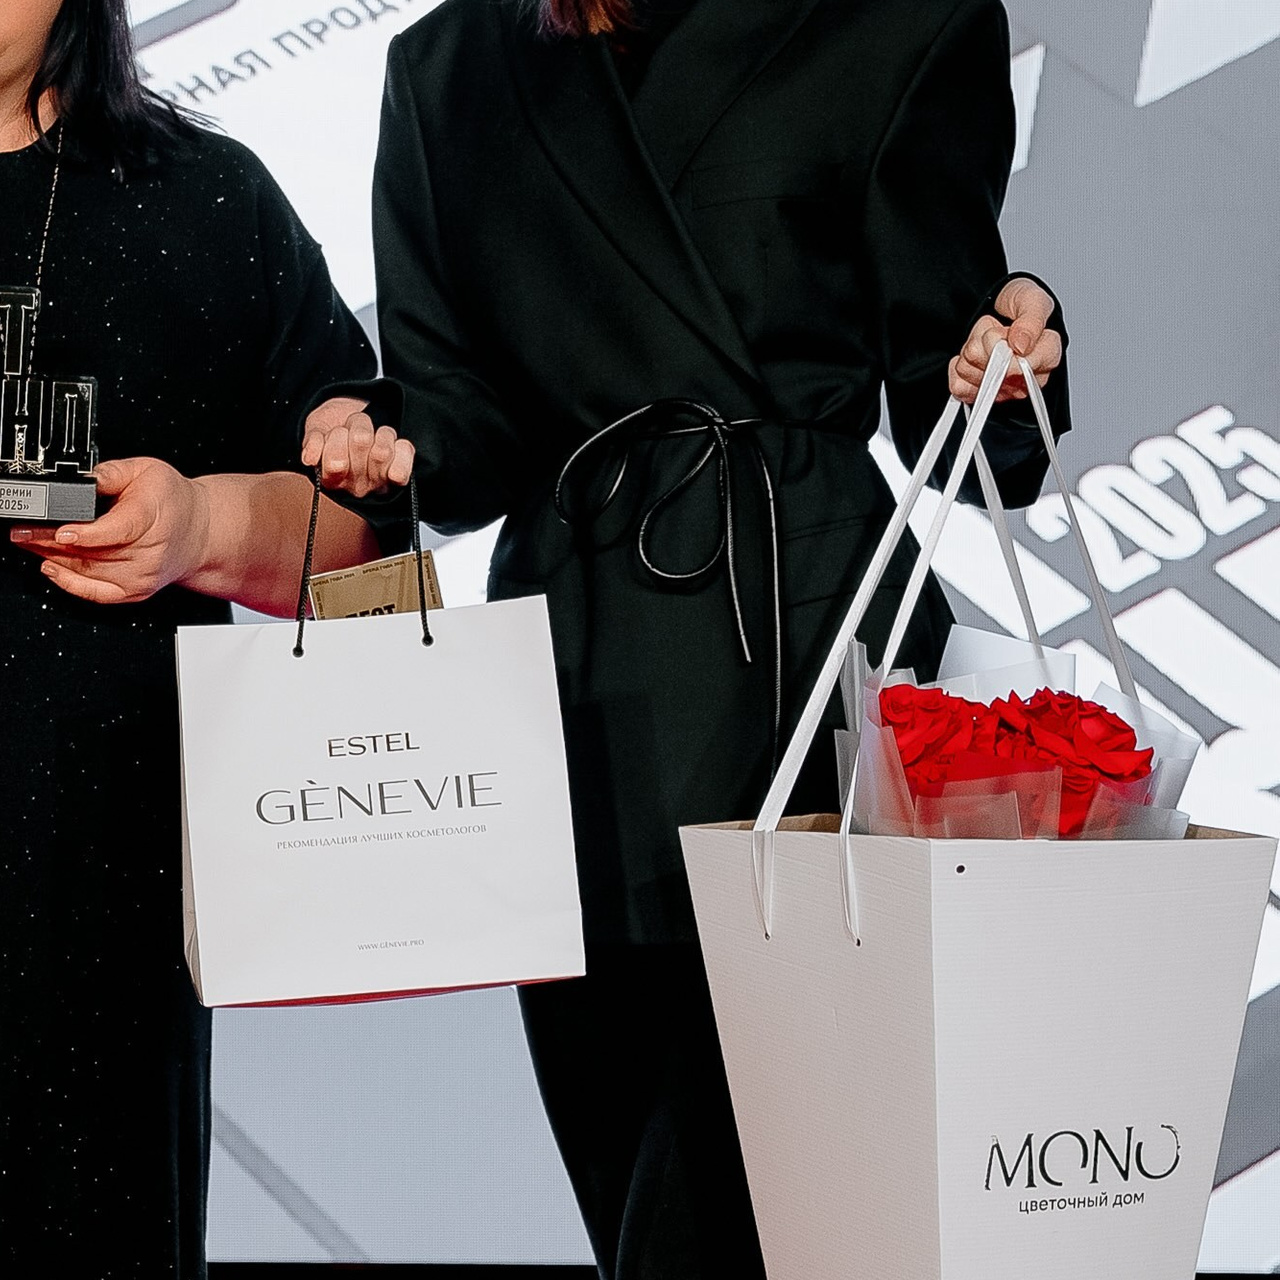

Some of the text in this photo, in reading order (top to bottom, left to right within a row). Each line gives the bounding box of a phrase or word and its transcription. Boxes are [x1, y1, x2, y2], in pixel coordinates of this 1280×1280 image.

[327, 732, 420, 758] ESTEL
[256, 772, 502, 825] GÈNEVIE
[277, 824, 487, 850] РЕКОМЕНДАЦИЯ ЛУЧШИХ КОСМЕТОЛОГОВ
[985, 1124, 1181, 1191] MONO
[1019, 1191, 1145, 1214] цветочный дом
